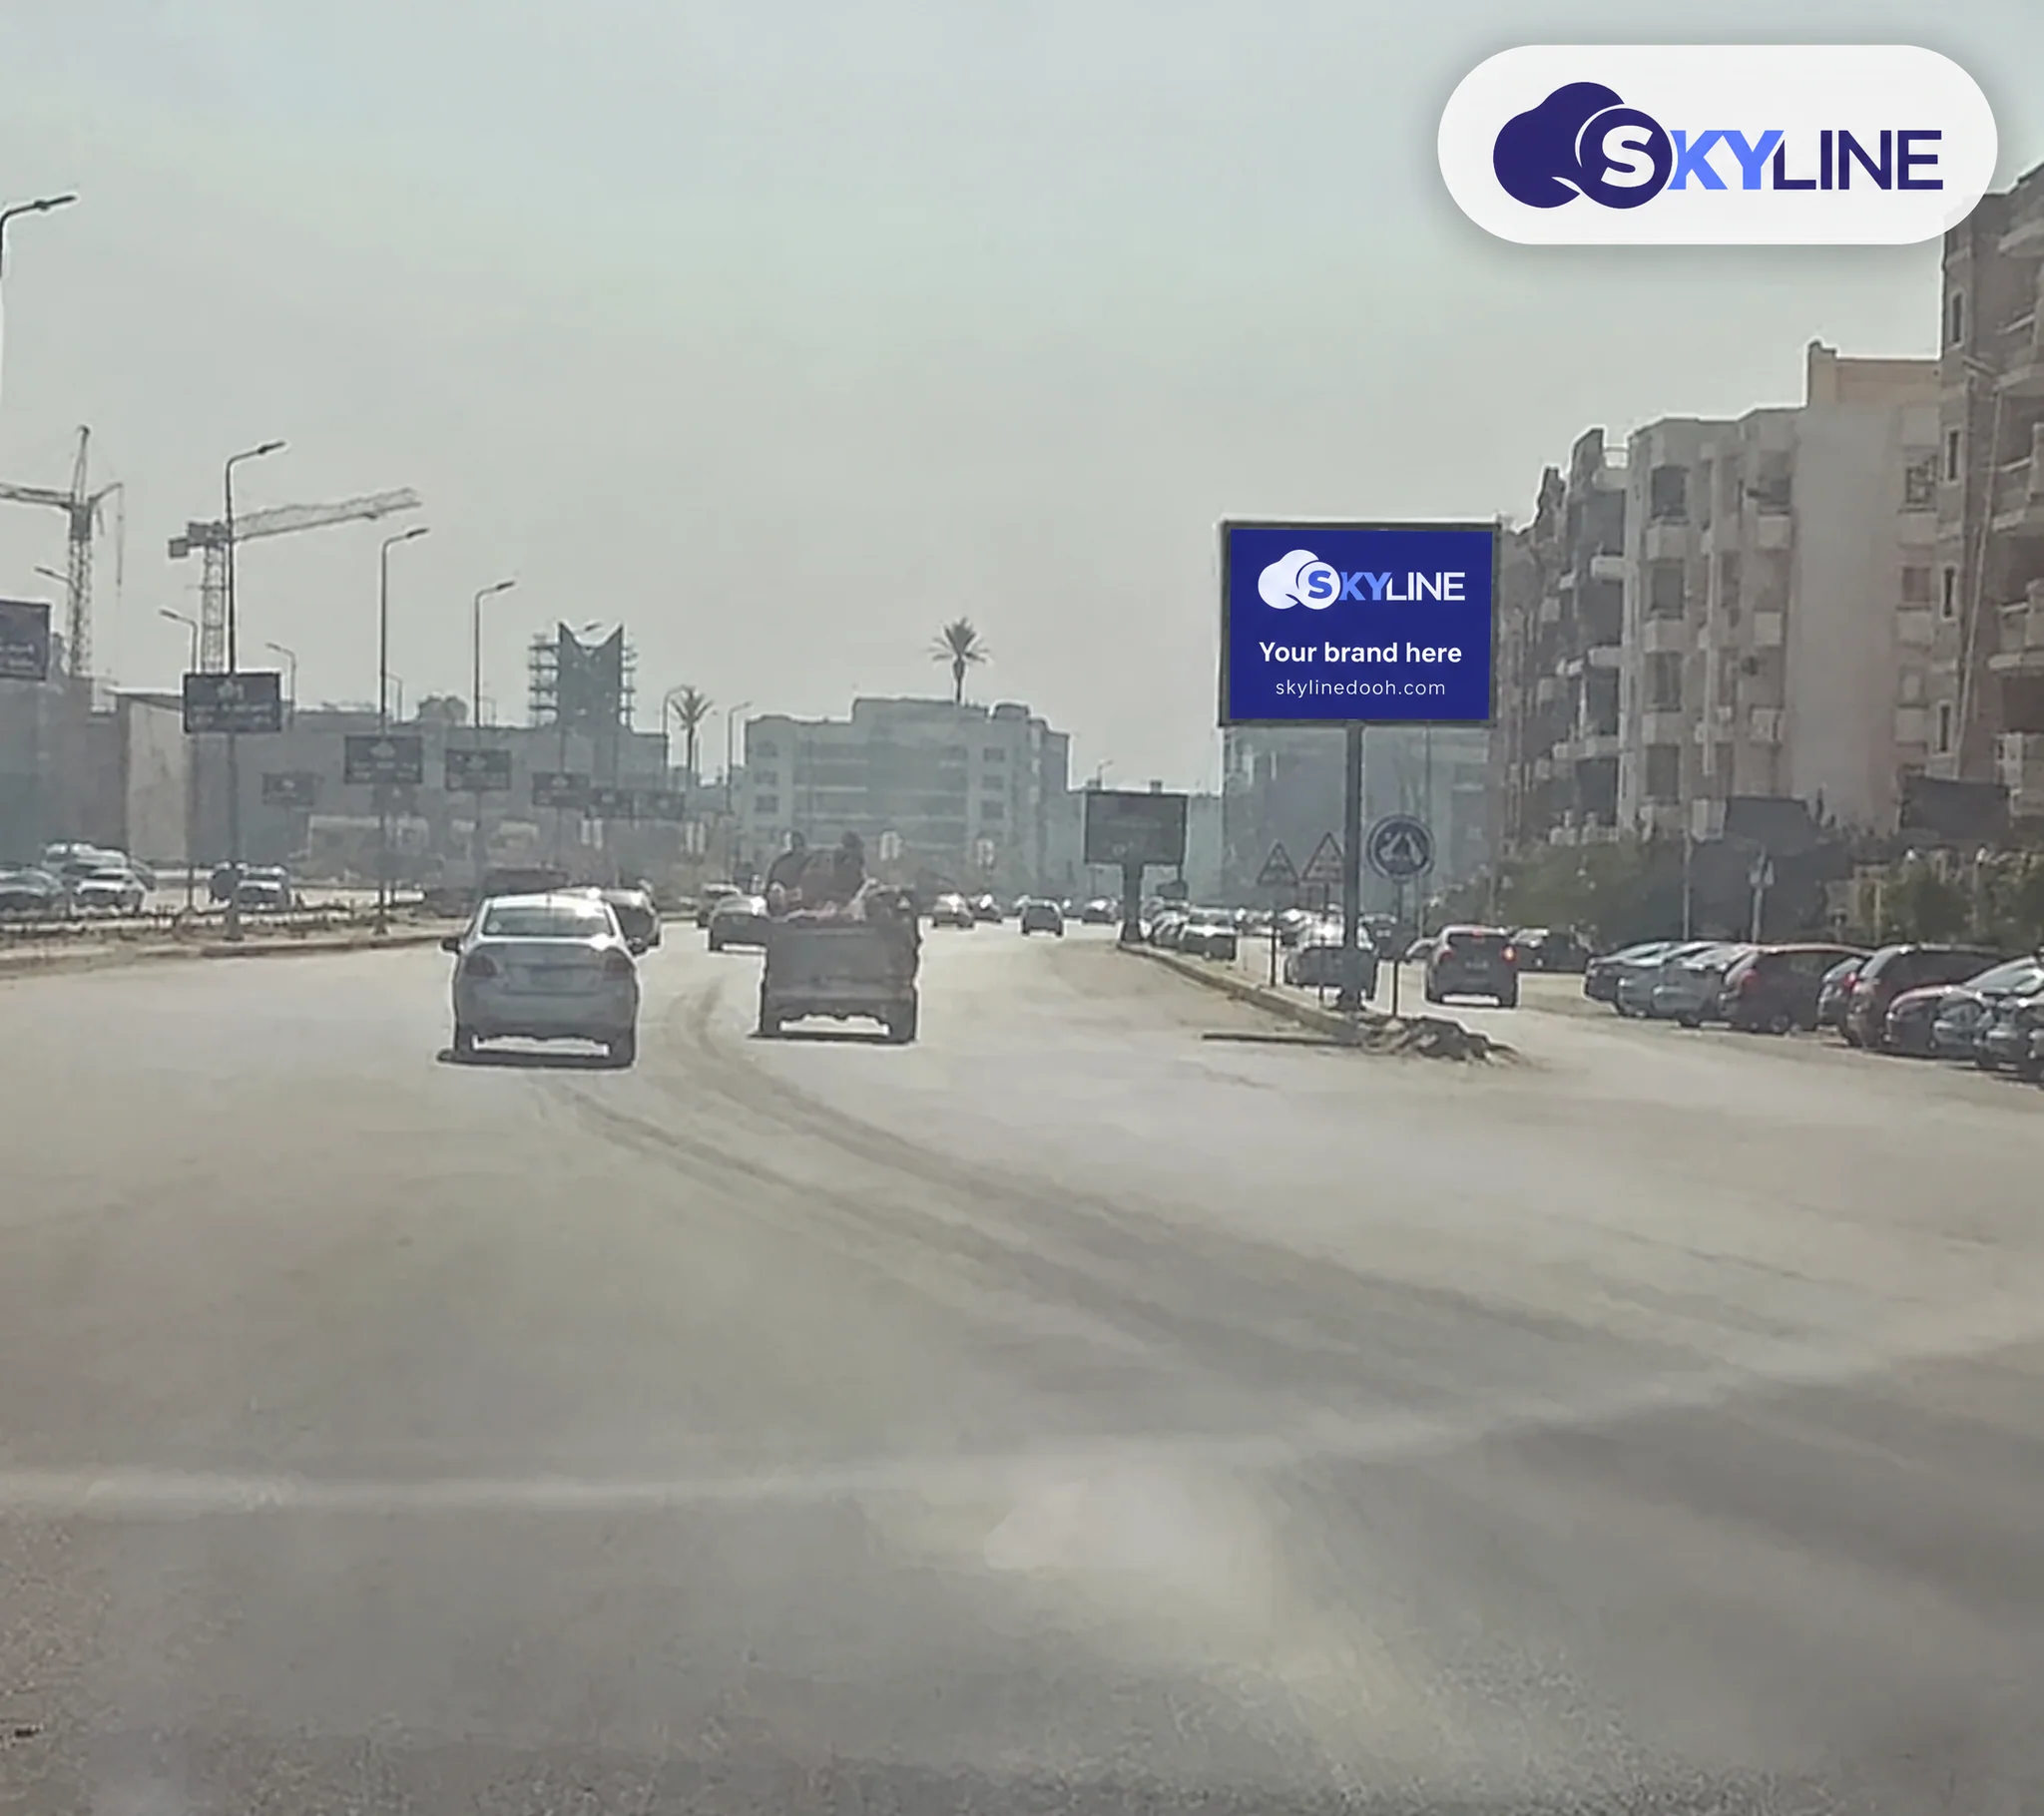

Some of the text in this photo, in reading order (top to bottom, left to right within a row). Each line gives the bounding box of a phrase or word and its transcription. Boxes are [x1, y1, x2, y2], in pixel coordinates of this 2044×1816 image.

[1307, 570, 1465, 601] SKYLINE
[1259, 642, 1462, 663] Your brand here
[1276, 680, 1445, 698] skylinedooh.com
